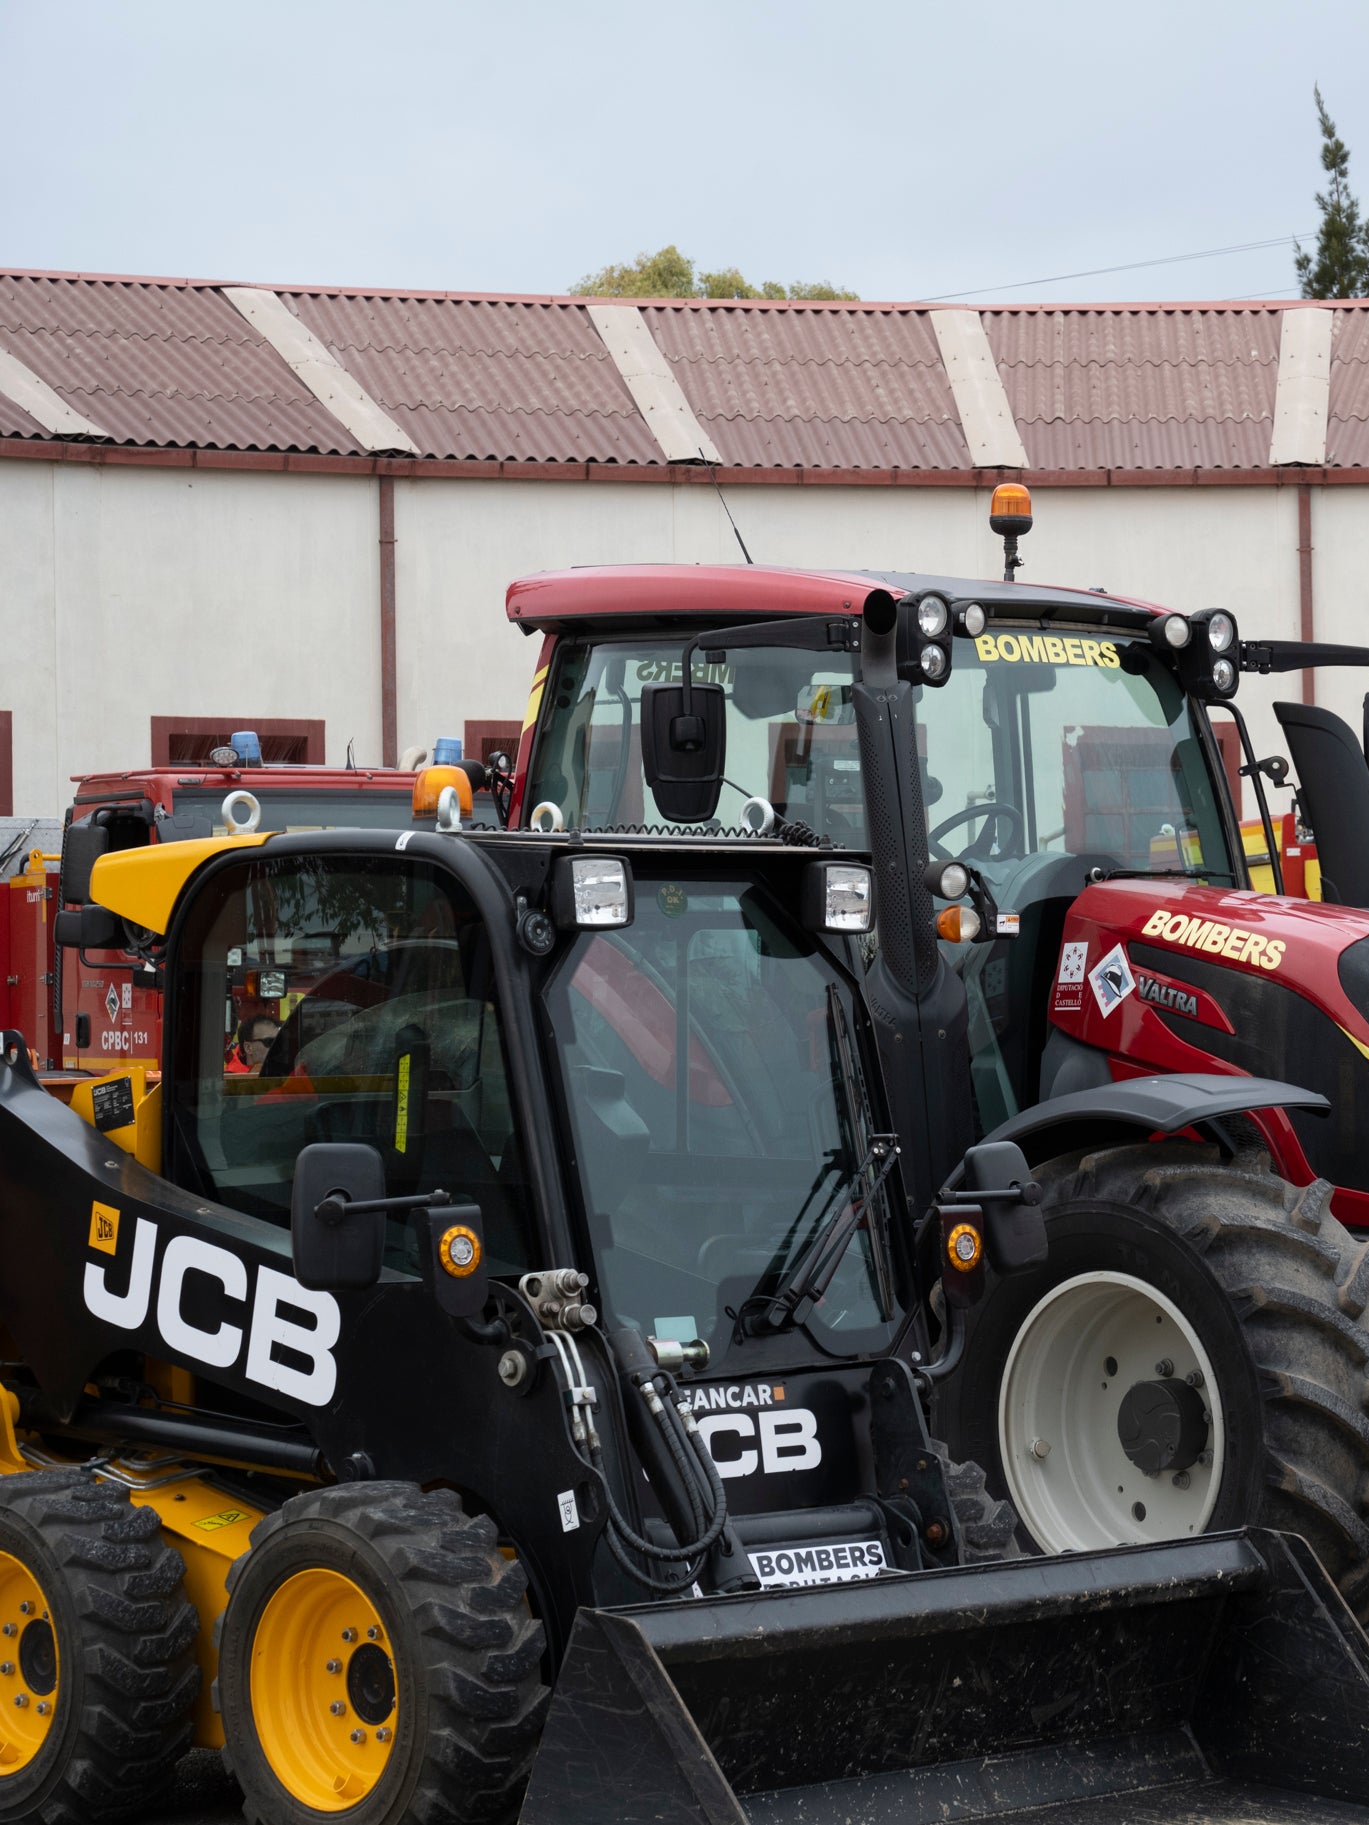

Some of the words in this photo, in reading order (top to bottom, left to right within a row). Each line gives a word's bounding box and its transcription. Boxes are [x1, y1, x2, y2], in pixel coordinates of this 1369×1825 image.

[974, 634, 1121, 669] BOMBERS
[1141, 910, 1287, 970] BOMBERS
[1138, 974, 1198, 1017] VALTRA
[101, 1031, 129, 1050] CPBC
[134, 1032, 148, 1044] 131
[98, 1216, 113, 1238] JCB
[83, 1217, 341, 1407] JCB
[683, 1384, 773, 1411] ANCAR
[696, 1408, 822, 1479] CB
[756, 1543, 883, 1578] BOMBERS
